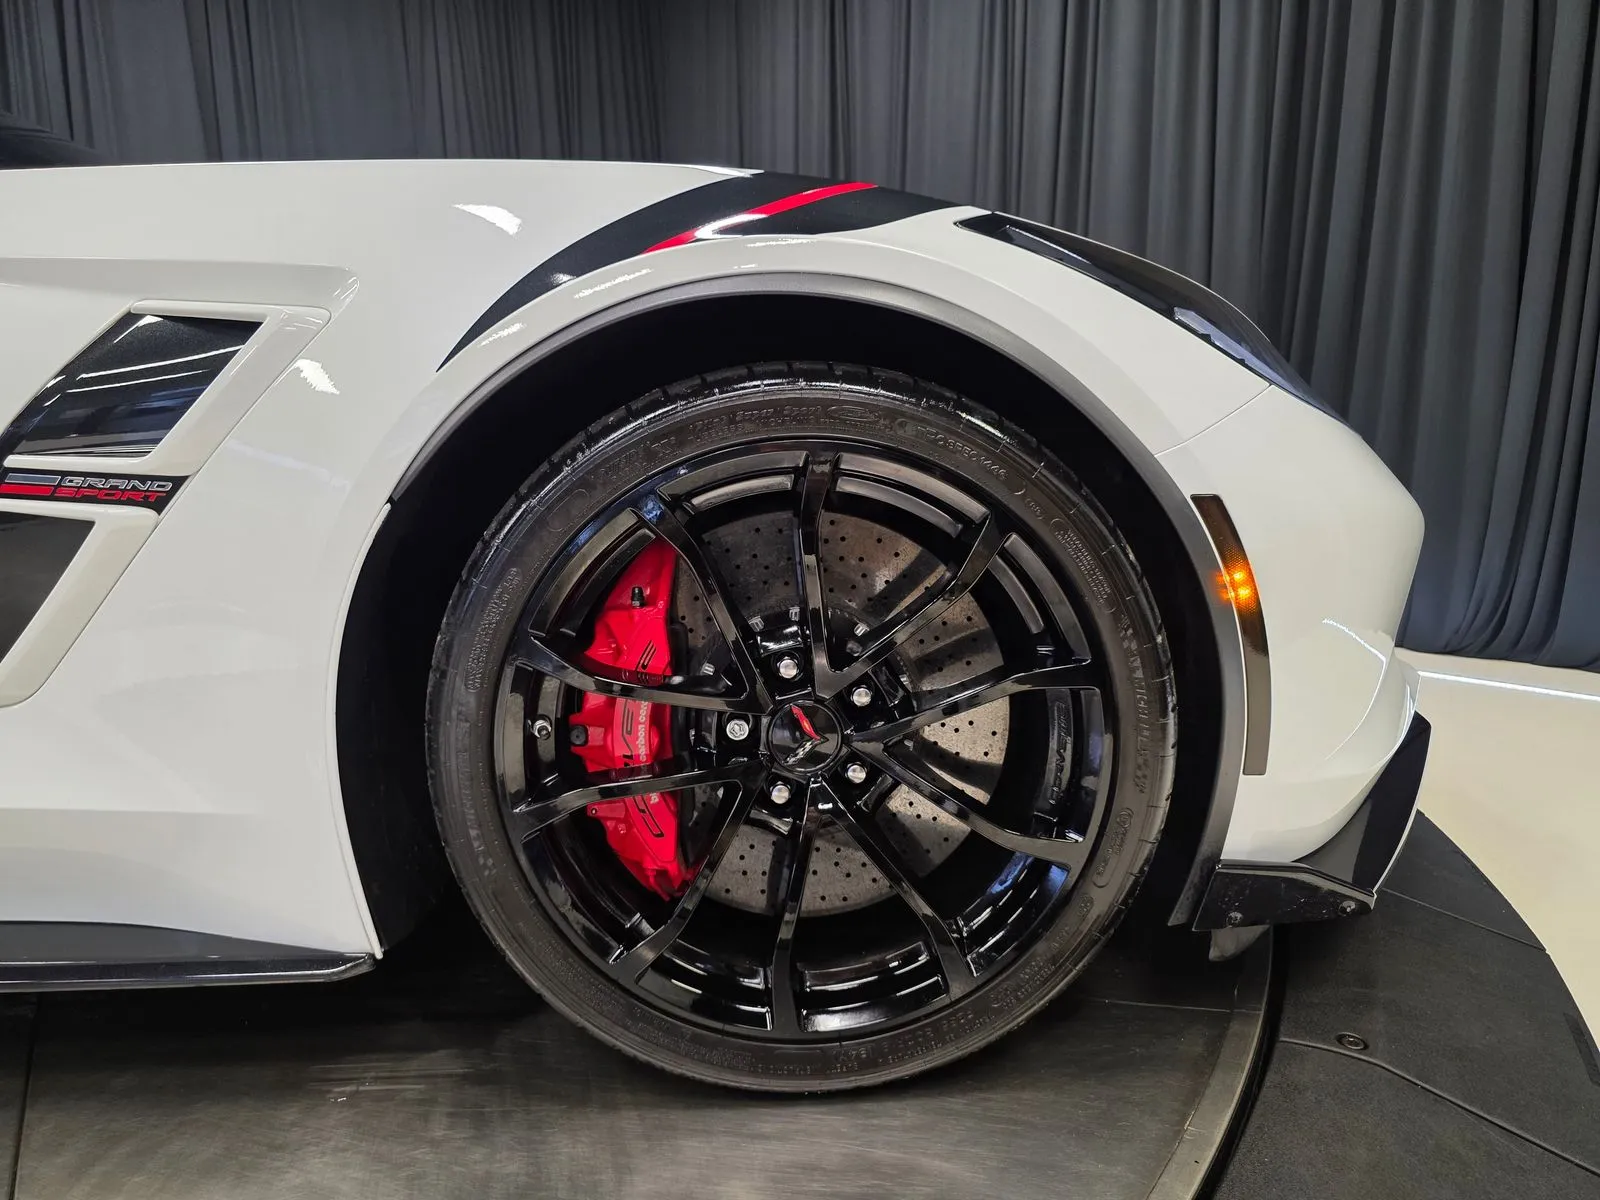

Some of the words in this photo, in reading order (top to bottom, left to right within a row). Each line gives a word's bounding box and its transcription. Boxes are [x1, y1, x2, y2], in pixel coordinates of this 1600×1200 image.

[61, 476, 173, 491] GRAND
[53, 487, 167, 502] SPORT
[636, 724, 648, 763] carbon
